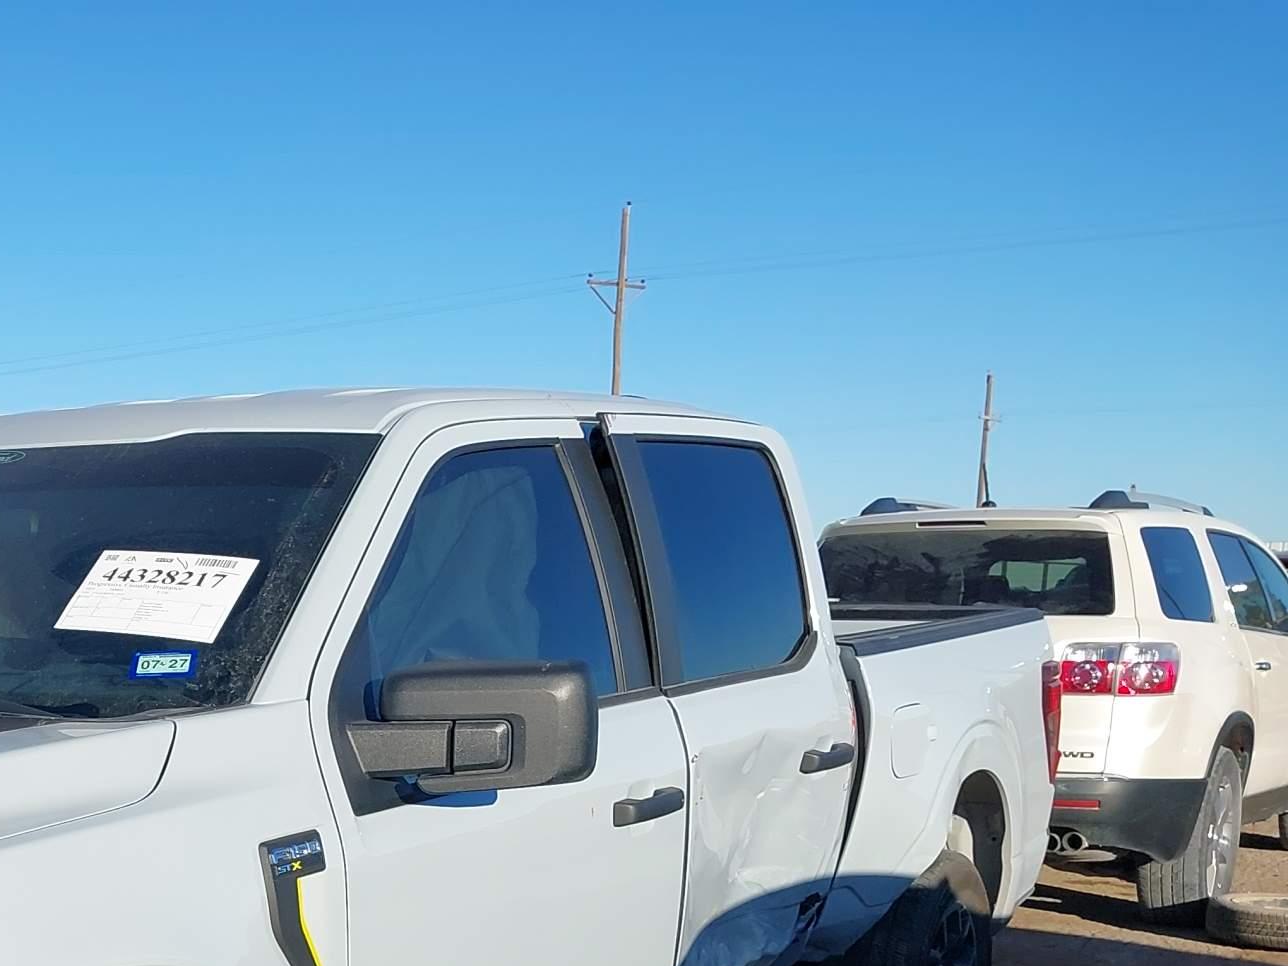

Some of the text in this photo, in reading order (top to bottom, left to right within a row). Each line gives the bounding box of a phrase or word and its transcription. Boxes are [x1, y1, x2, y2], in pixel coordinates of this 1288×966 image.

[102, 567, 228, 589] 44328217
[1062, 751, 1095, 759] WD
[278, 860, 303, 874] STX
